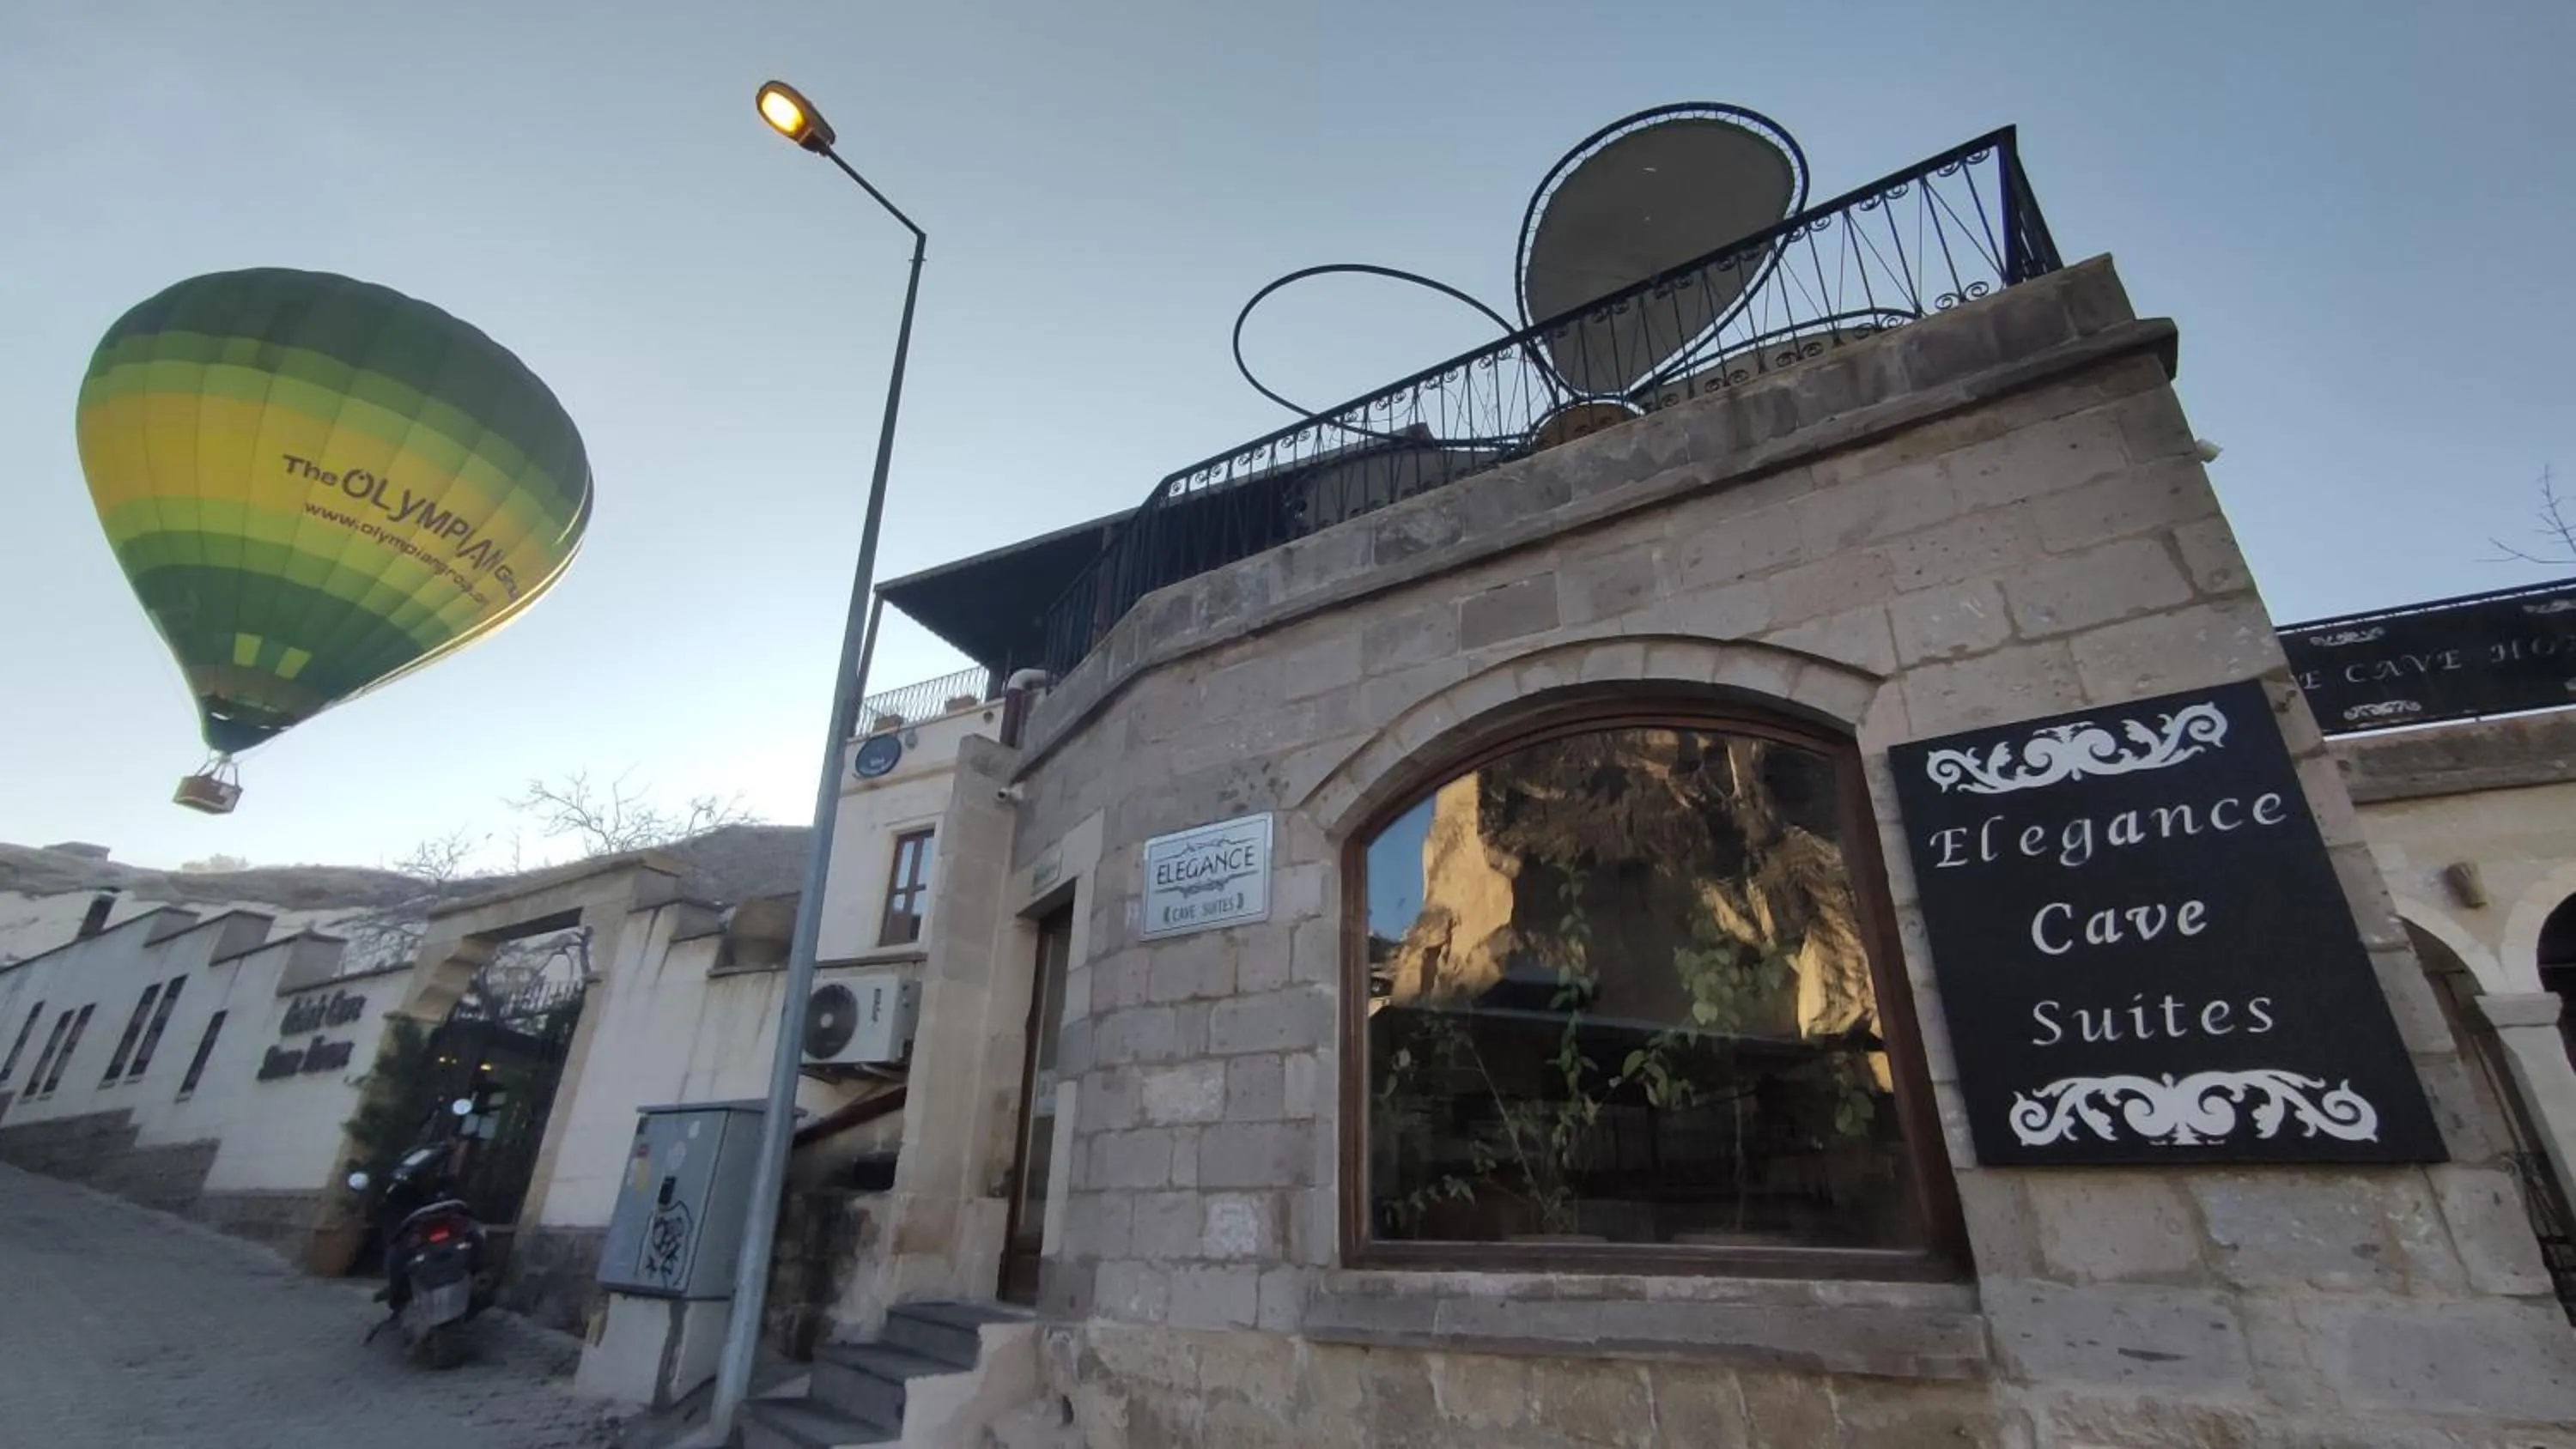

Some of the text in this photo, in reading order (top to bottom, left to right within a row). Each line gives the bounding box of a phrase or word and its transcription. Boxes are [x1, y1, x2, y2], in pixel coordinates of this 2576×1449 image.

[283, 453, 339, 486] The
[2345, 649, 2462, 683] CAVE
[1930, 791, 2287, 868] Elegance
[1157, 845, 1255, 885] ELEGANCE
[2032, 898, 2208, 955] Cave
[2032, 992, 2275, 1046] Suites
